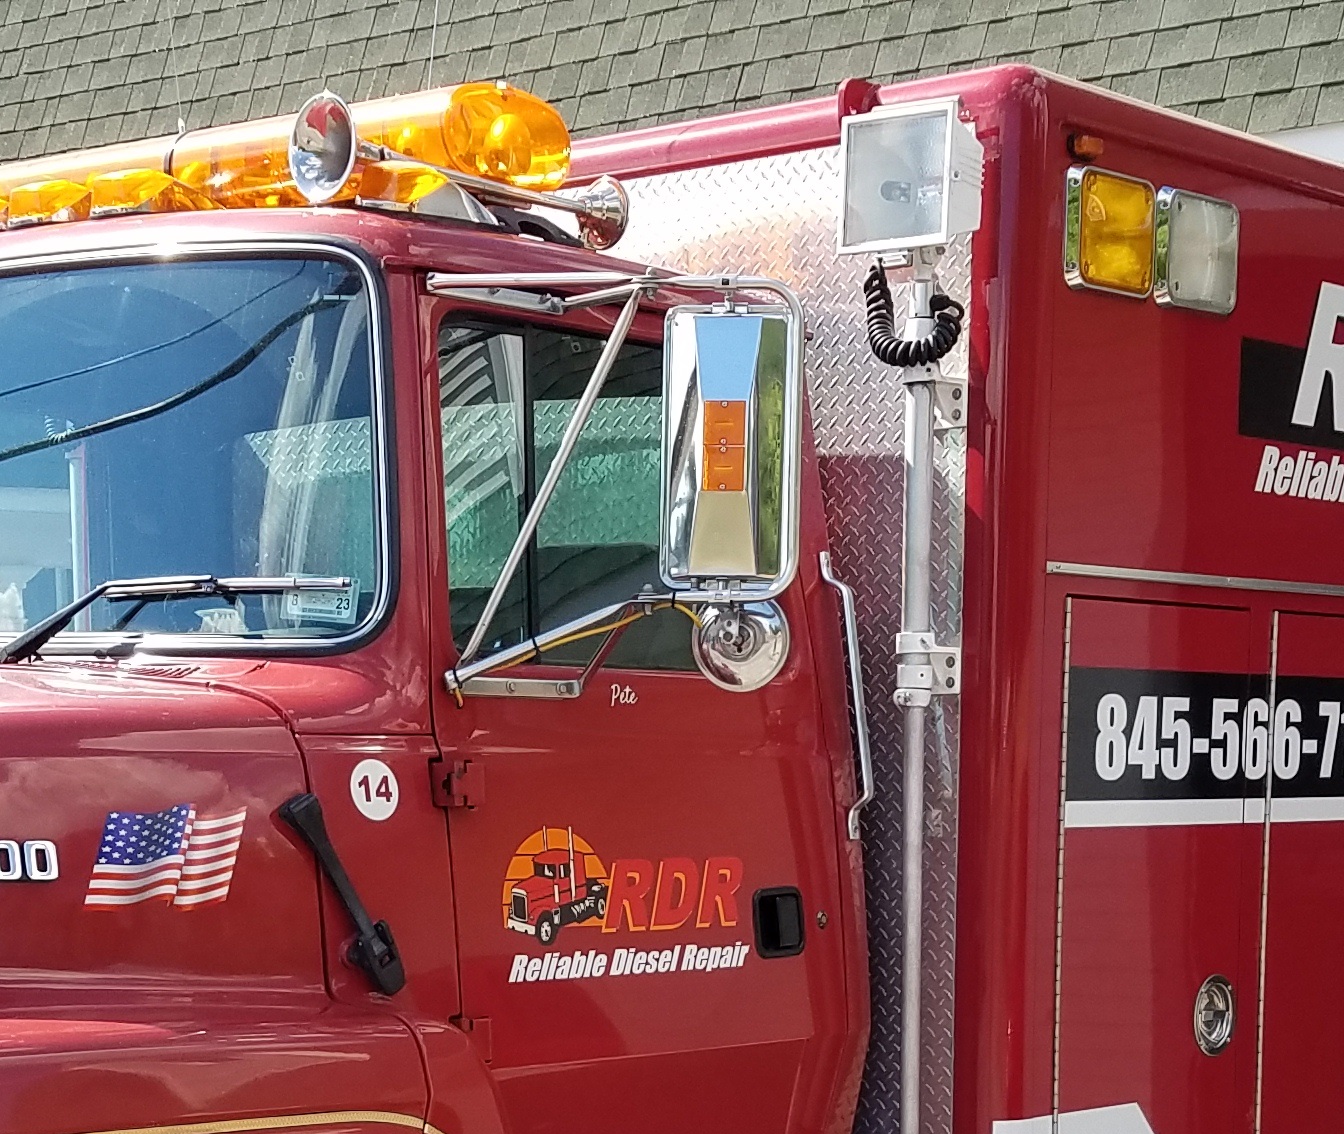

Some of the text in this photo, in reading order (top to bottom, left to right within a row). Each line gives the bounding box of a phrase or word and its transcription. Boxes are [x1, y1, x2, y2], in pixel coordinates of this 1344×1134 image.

[335, 597, 351, 611] 23
[610, 683, 639, 707] Pete
[357, 774, 394, 804] 14
[601, 857, 744, 934] RDR
[508, 941, 751, 983] Reliable Diesel Repair
